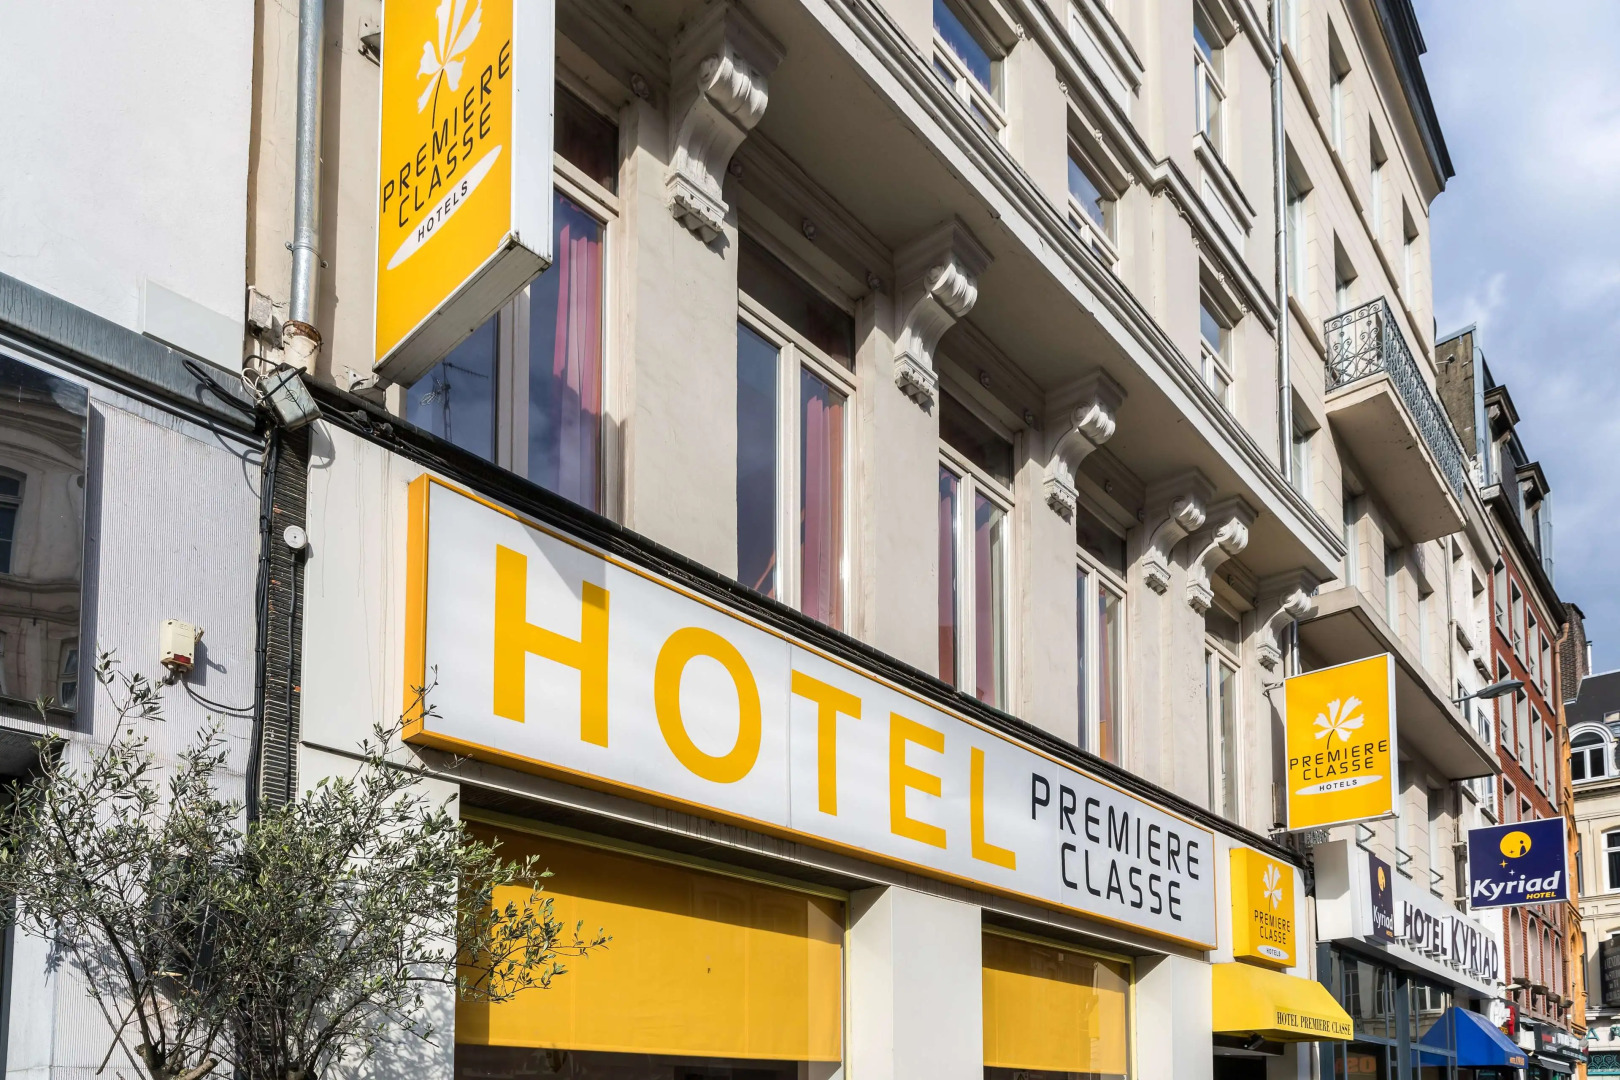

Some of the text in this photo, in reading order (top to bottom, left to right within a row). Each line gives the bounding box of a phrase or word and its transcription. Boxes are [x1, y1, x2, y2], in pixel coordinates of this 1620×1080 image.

[382, 39, 510, 213] PREMIERE
[398, 101, 491, 228] CLASSE
[417, 180, 468, 243] HOTELS
[493, 543, 1017, 871] HOTEL
[1289, 740, 1388, 770] PREMIERE
[1302, 756, 1374, 781] CLASSE
[1319, 779, 1358, 791] HOTELS
[1031, 772, 1200, 881] PREMIERE
[1060, 842, 1182, 921] CLASSE
[1472, 870, 1561, 901] Kyriad
[1526, 891, 1556, 900] HOTEL
[1254, 909, 1291, 933] PREMIERE
[1373, 904, 1394, 931] Kyriad
[1260, 925, 1287, 945] CLASSE
[1403, 900, 1499, 980] HOTEL KYRIAD
[1276, 1011, 1352, 1036] HOTEL PREMIERE CLASSE
